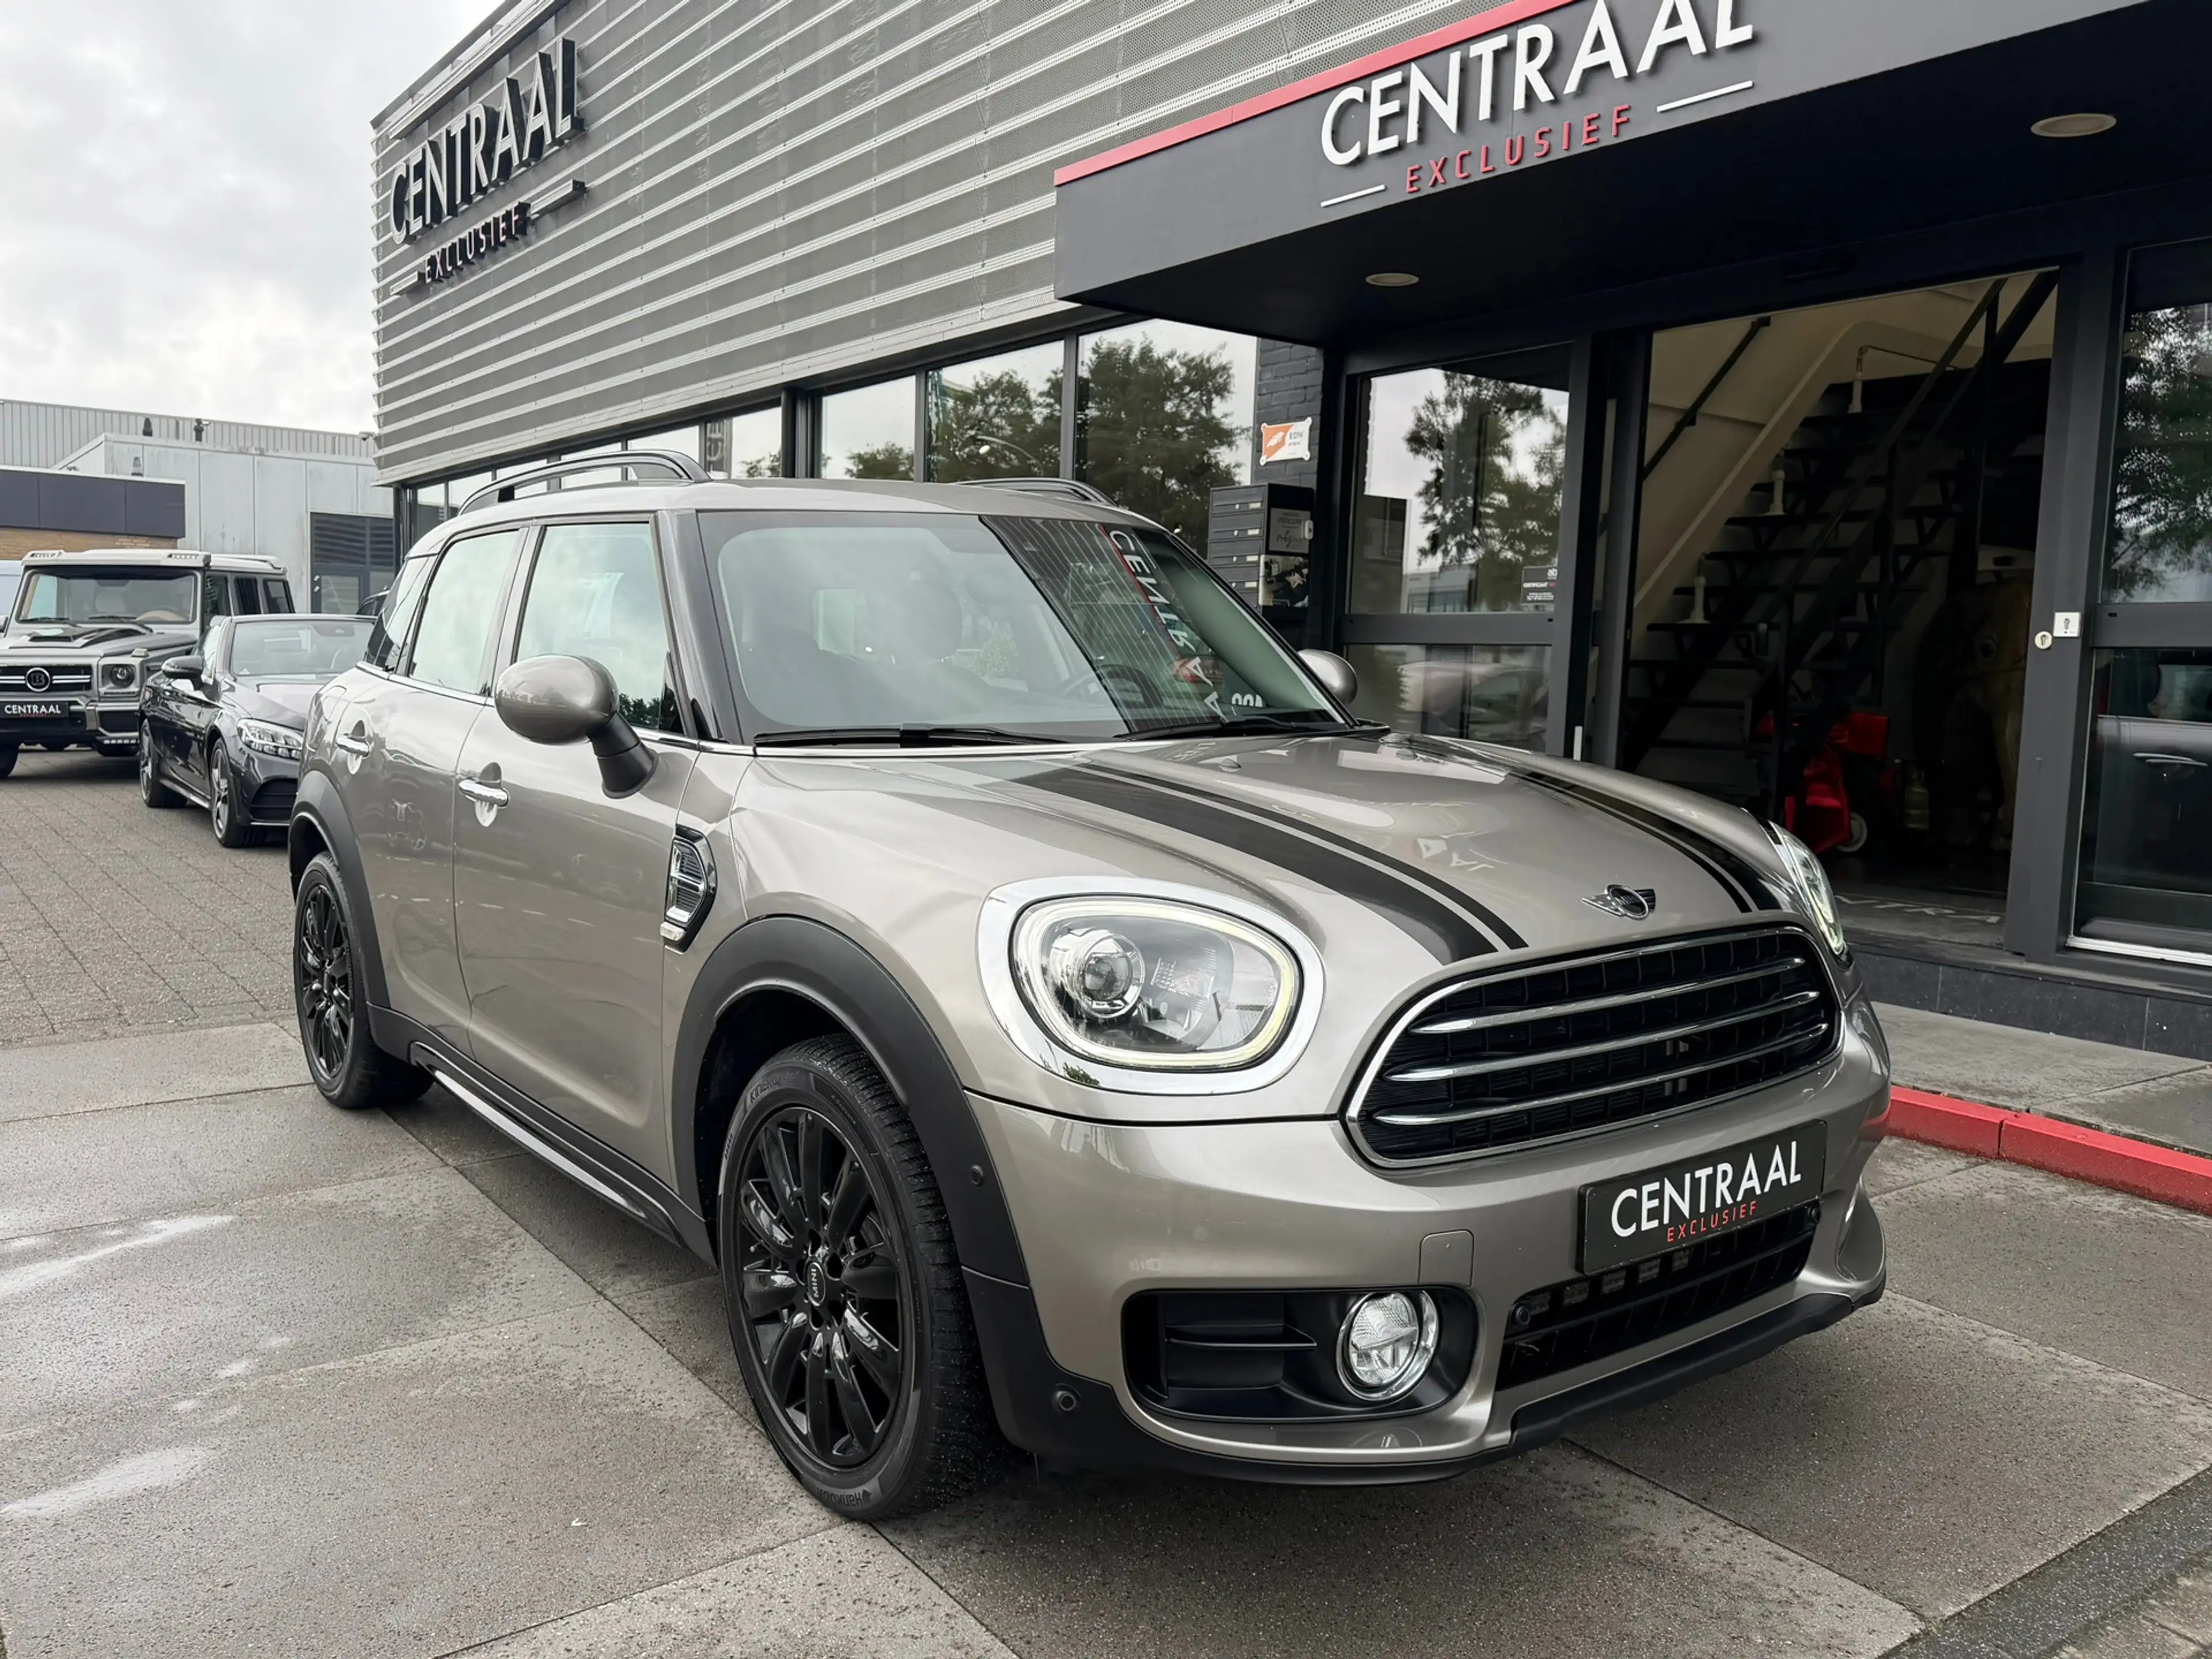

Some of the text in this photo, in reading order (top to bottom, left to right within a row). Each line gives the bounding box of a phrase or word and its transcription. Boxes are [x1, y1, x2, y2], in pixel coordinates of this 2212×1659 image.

[1320, 0, 1753, 166] CENTRAAL
[389, 37, 578, 244] CENTRAAL
[1406, 104, 1630, 194] EXCLUSIEF
[424, 204, 525, 284] EXCLUSIEF
[5, 704, 62, 714] CENTRAAL
[1611, 1141, 1802, 1237] CENTRAAL
[1666, 1200, 1758, 1243] EXCLUSIEF
[811, 1268, 819, 1298] MINI
